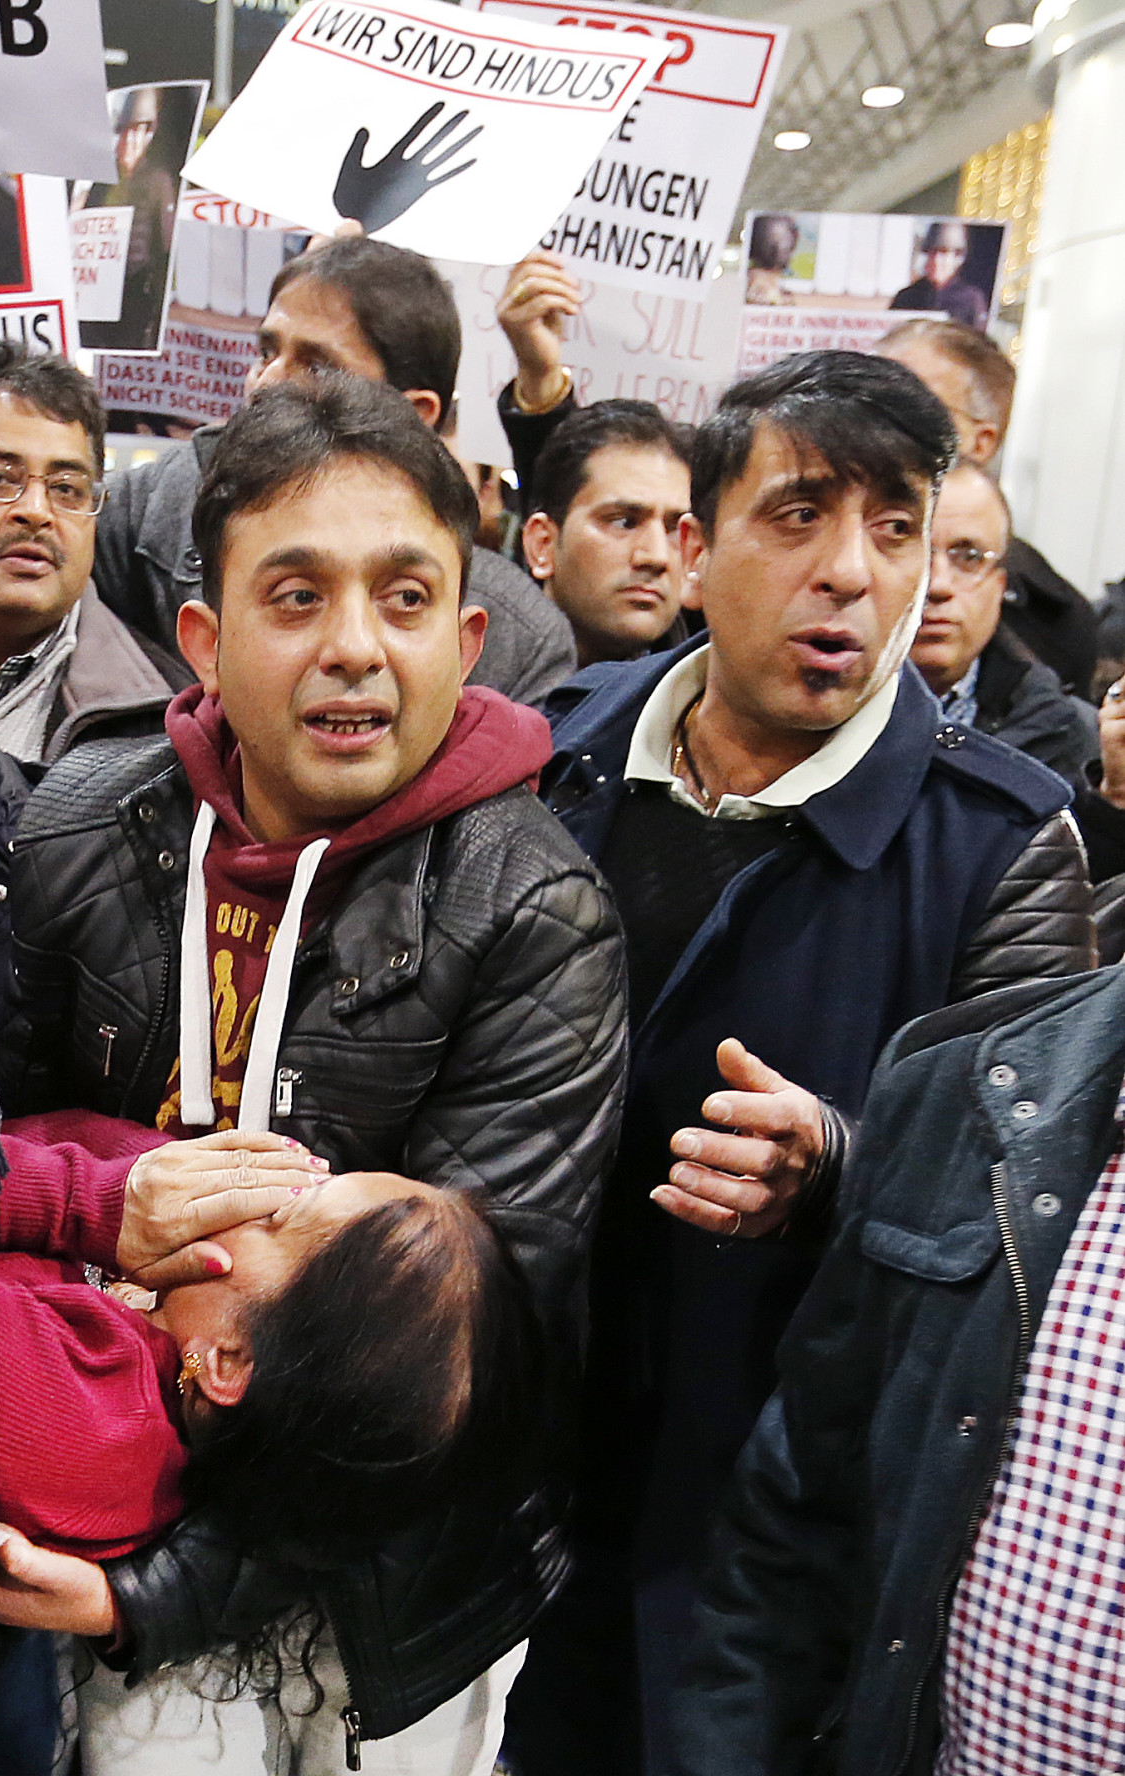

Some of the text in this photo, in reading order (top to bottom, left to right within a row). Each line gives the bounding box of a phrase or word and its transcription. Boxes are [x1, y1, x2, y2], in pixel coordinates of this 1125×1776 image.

[312, 7, 386, 55] WIR
[381, 26, 476, 80] SIND
[473, 48, 626, 102] HINDUS
[107, 363, 156, 383] DASS
[177, 351, 201, 370] SIE
[106, 385, 233, 417] NICHT SICHER
[215, 902, 261, 943] OUT
